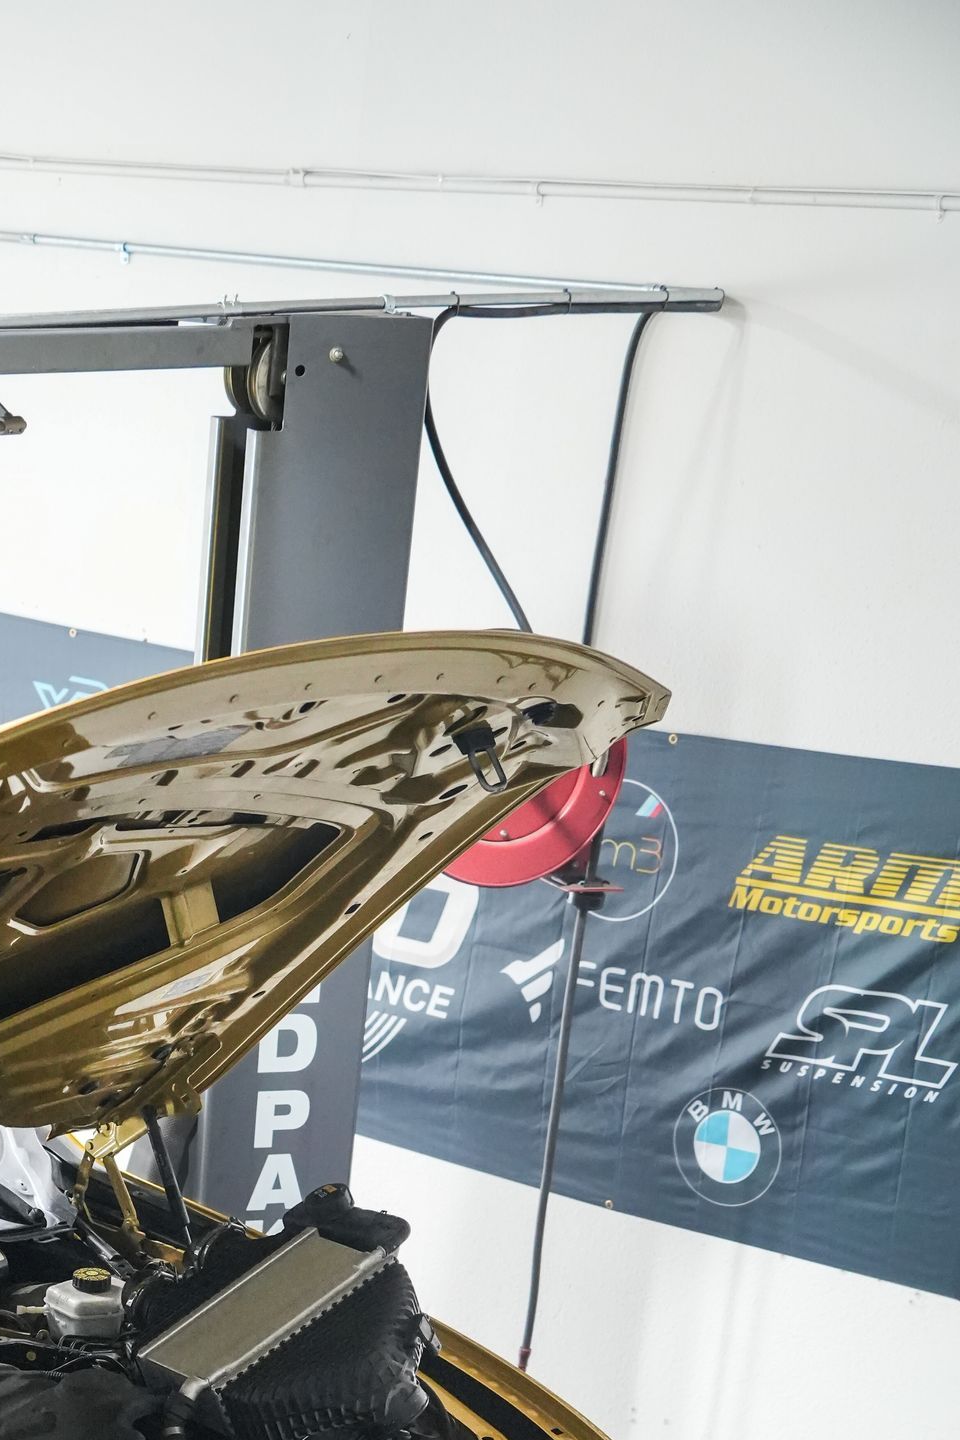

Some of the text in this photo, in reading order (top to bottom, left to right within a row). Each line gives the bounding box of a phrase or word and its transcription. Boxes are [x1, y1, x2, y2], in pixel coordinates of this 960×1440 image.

[740, 835, 960, 907] ARM
[727, 884, 960, 944] Motorsports
[367, 971, 456, 1020] NCE
[575, 960, 724, 1031] FEMTO
[764, 984, 959, 1089] SPL
[760, 1059, 940, 1103] SUSPENSION
[687, 1090, 775, 1136] BMW
